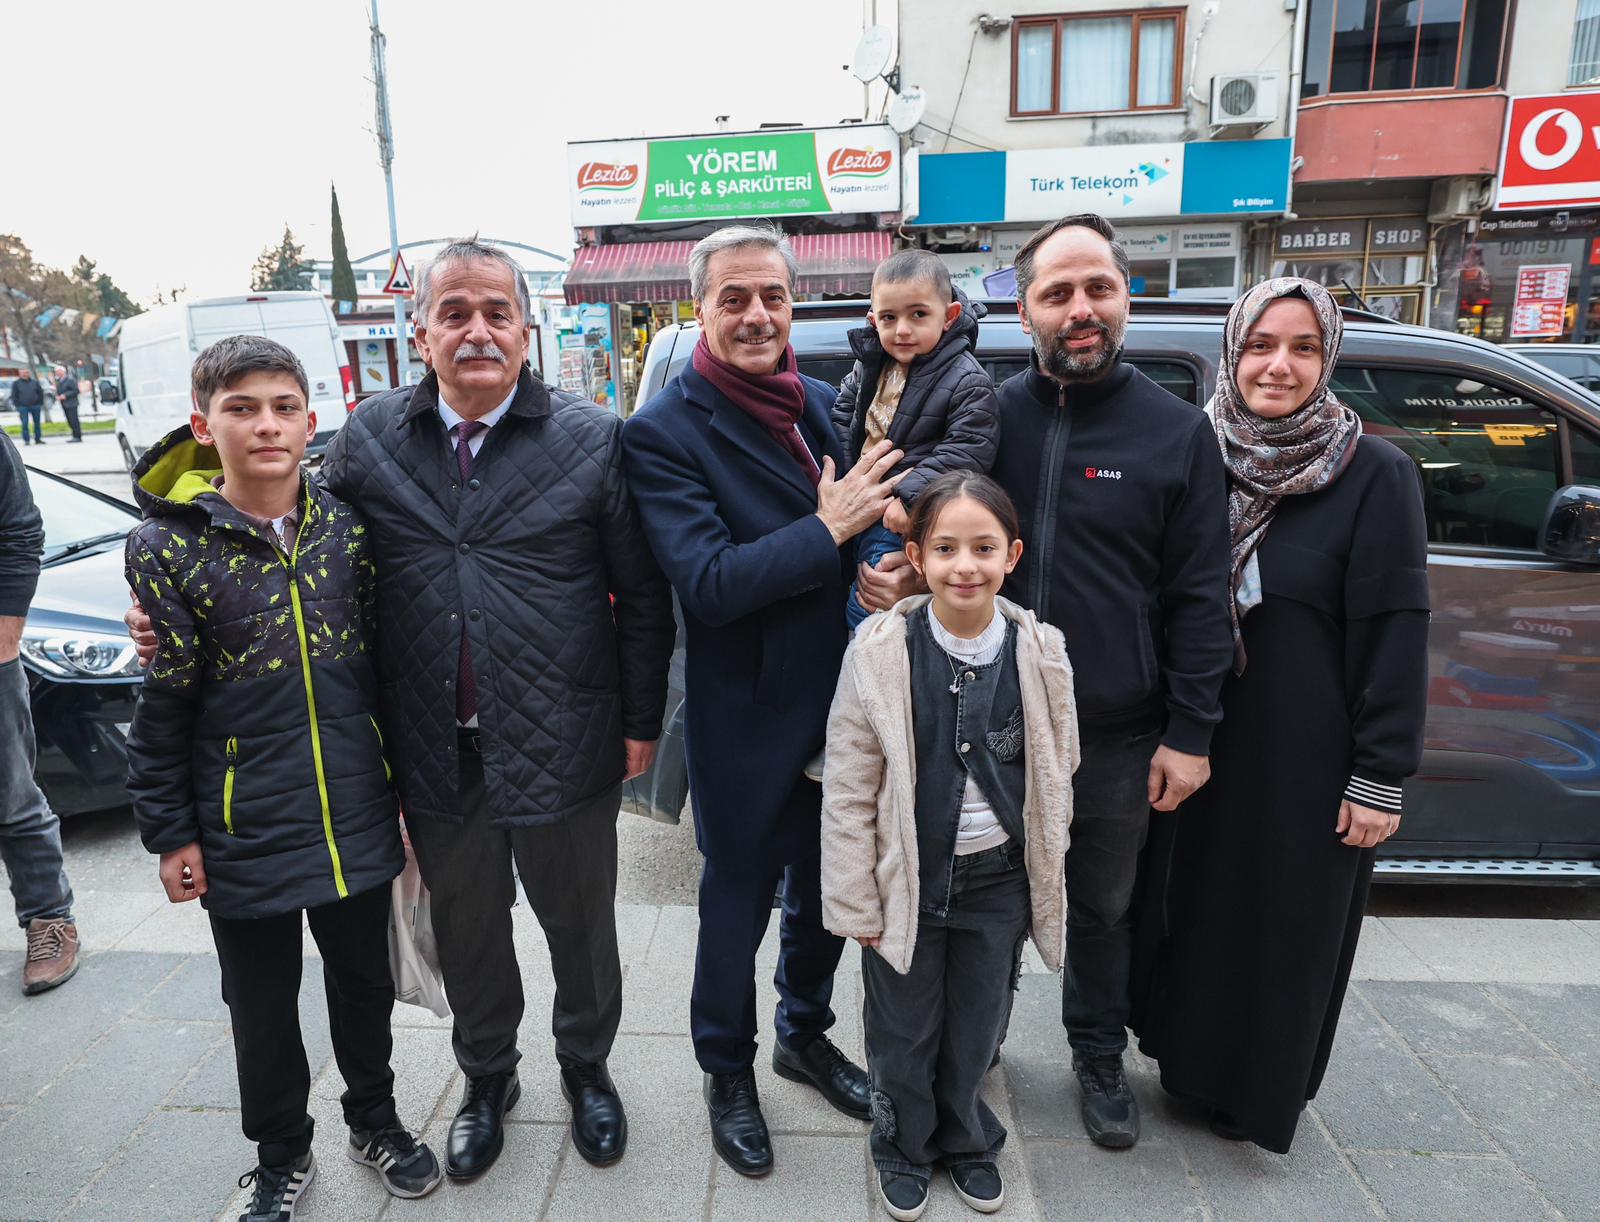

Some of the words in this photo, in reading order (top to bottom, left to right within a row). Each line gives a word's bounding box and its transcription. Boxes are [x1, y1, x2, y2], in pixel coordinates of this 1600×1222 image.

[686, 148, 777, 176] YÖREM
[832, 148, 885, 171] Lezita
[583, 162, 633, 185] Lezita
[655, 178, 696, 199] PİLİÇ
[700, 182, 712, 196] &
[716, 172, 812, 198] ŞARKÜTERİ
[830, 185, 862, 195] Hayatın
[864, 183, 889, 193] lezzeti
[1030, 178, 1064, 192] Türk
[1070, 176, 1139, 190] Telekom
[581, 199, 611, 208] Hayatın
[613, 197, 637, 205] lezzeti
[1481, 220, 1498, 231] Cep
[1499, 219, 1539, 229] Telefonu
[1281, 232, 1351, 249] BARBER
[1375, 229, 1422, 244] SHOP
[1096, 469, 1122, 480] ASAŞ
